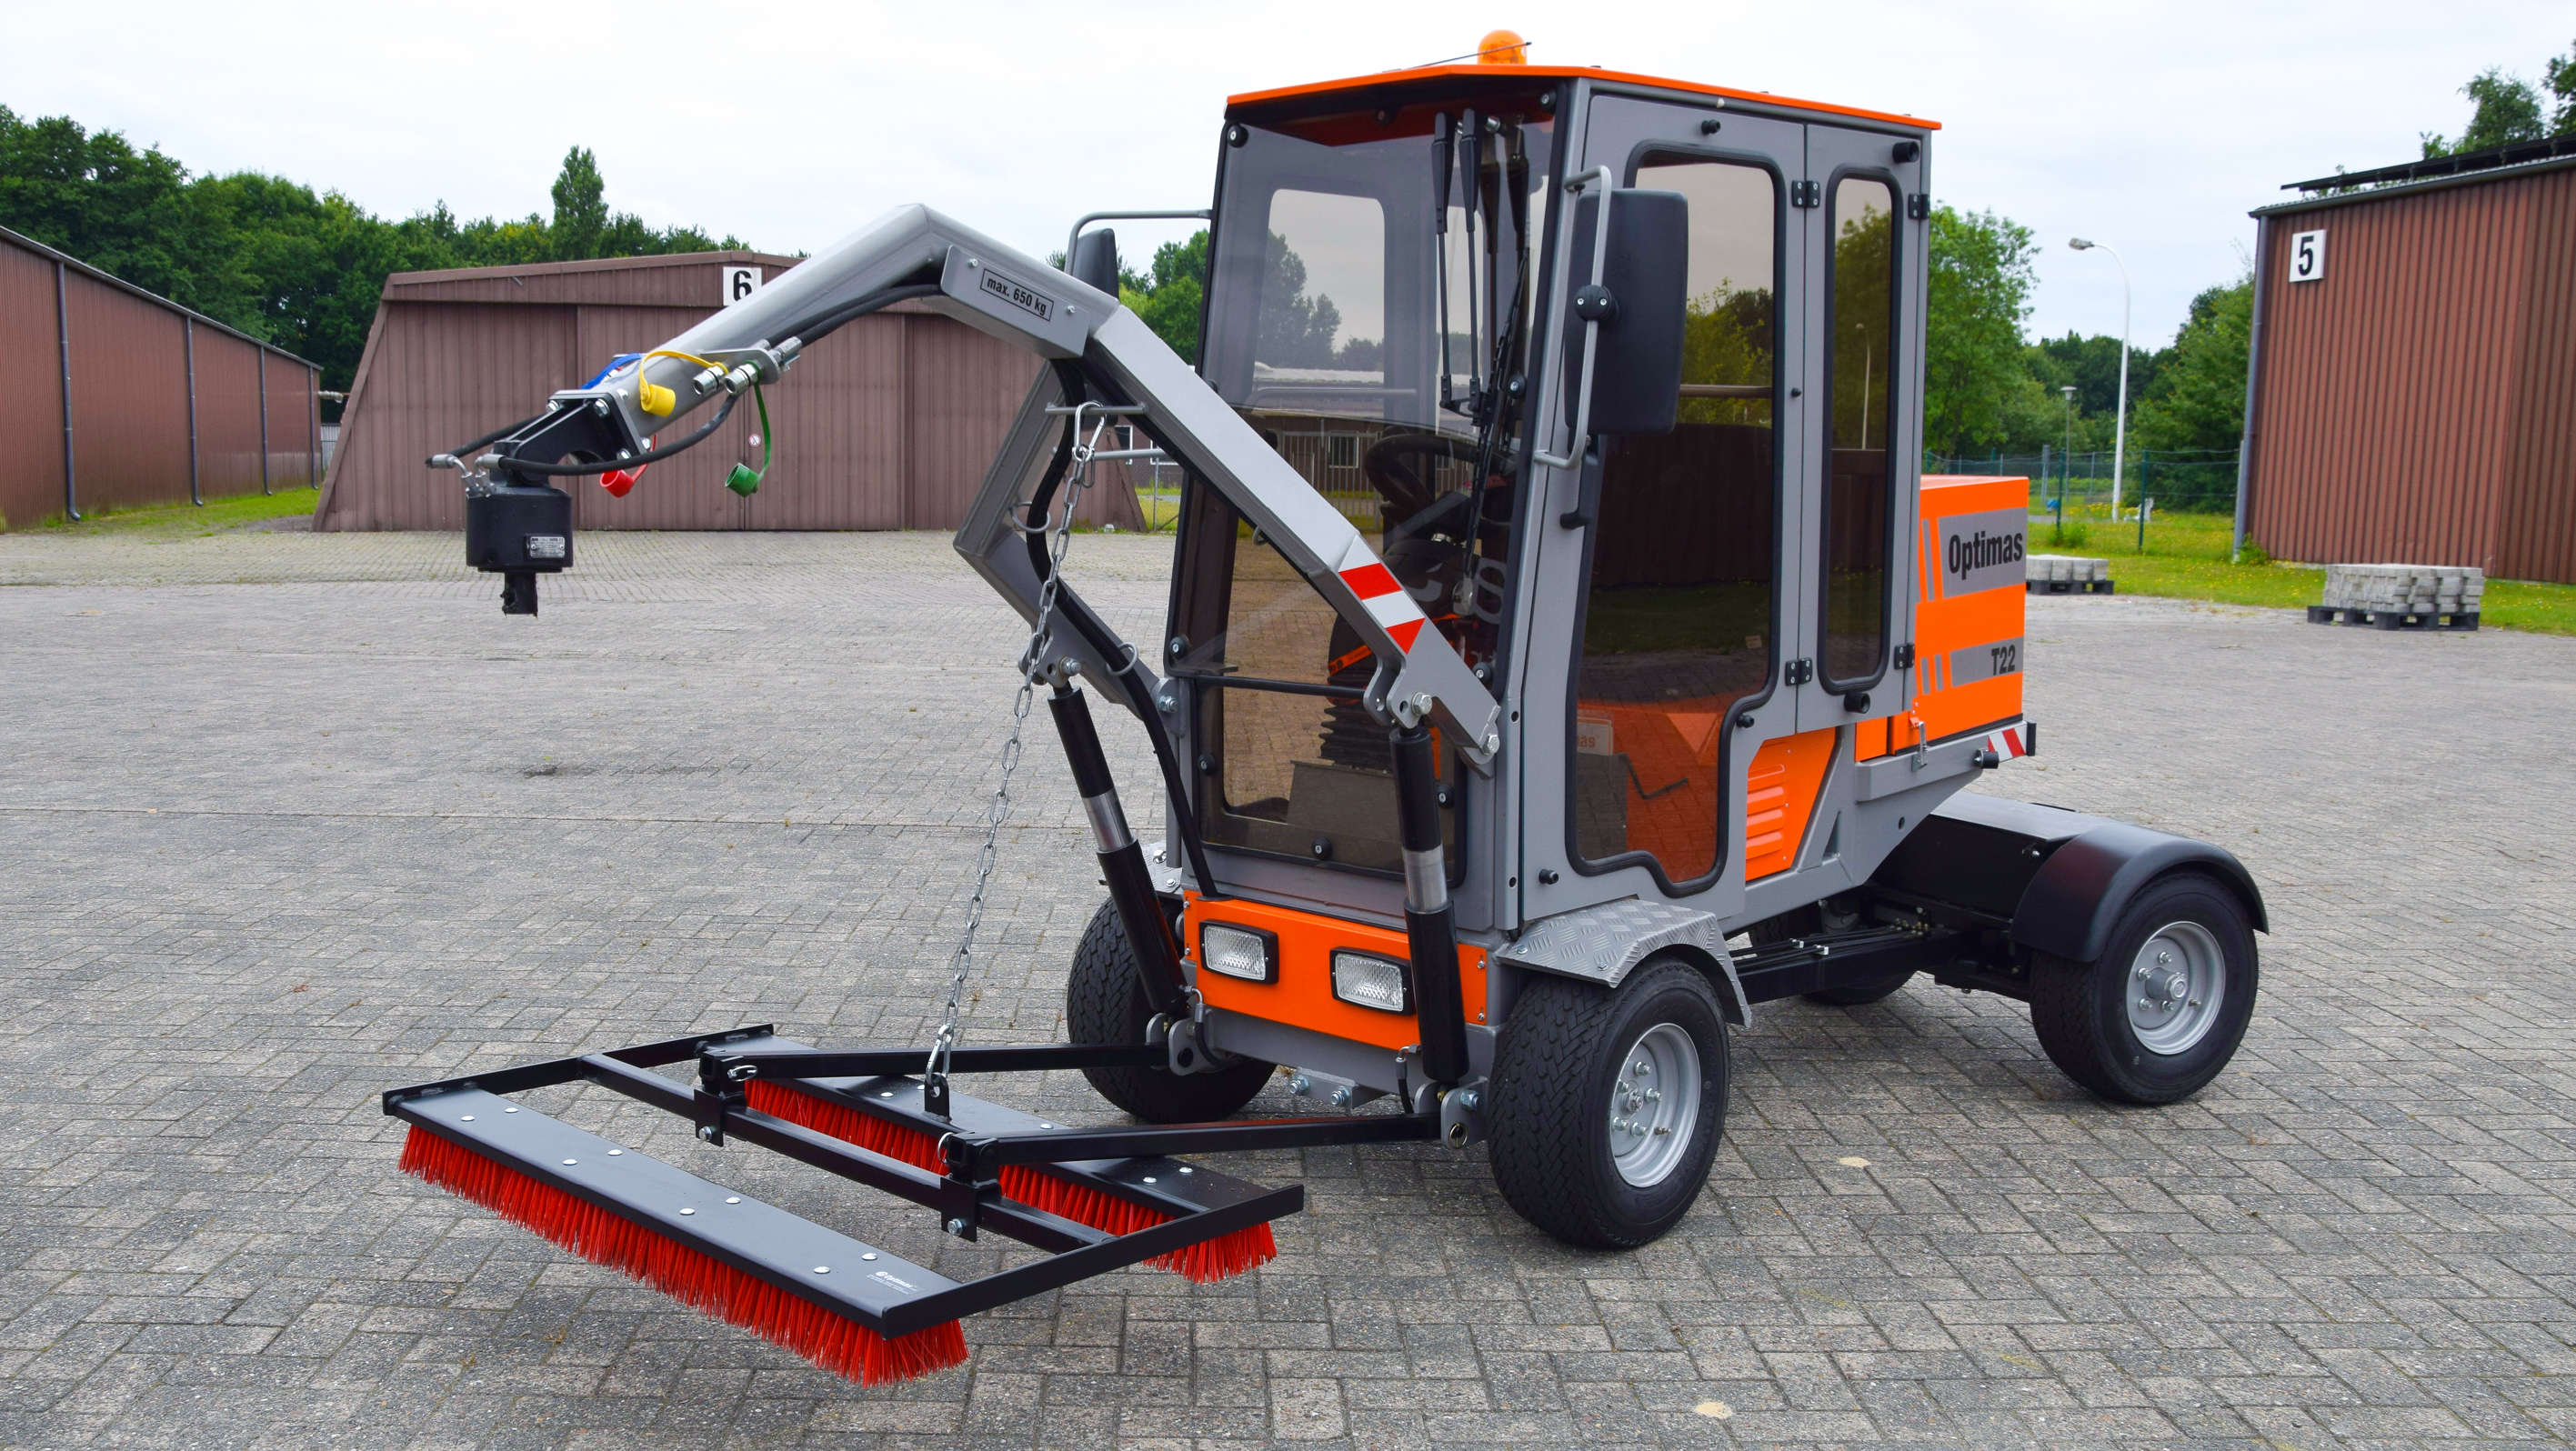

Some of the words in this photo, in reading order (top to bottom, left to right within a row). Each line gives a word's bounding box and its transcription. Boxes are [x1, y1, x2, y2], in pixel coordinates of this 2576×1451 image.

[2298, 235, 2315, 276] 5
[733, 270, 753, 302] 6
[987, 276, 1010, 298] max.
[1013, 287, 1033, 307] 650
[1034, 298, 1047, 316] kg
[1948, 530, 2024, 581] Optimas
[1991, 644, 2016, 676] T22
